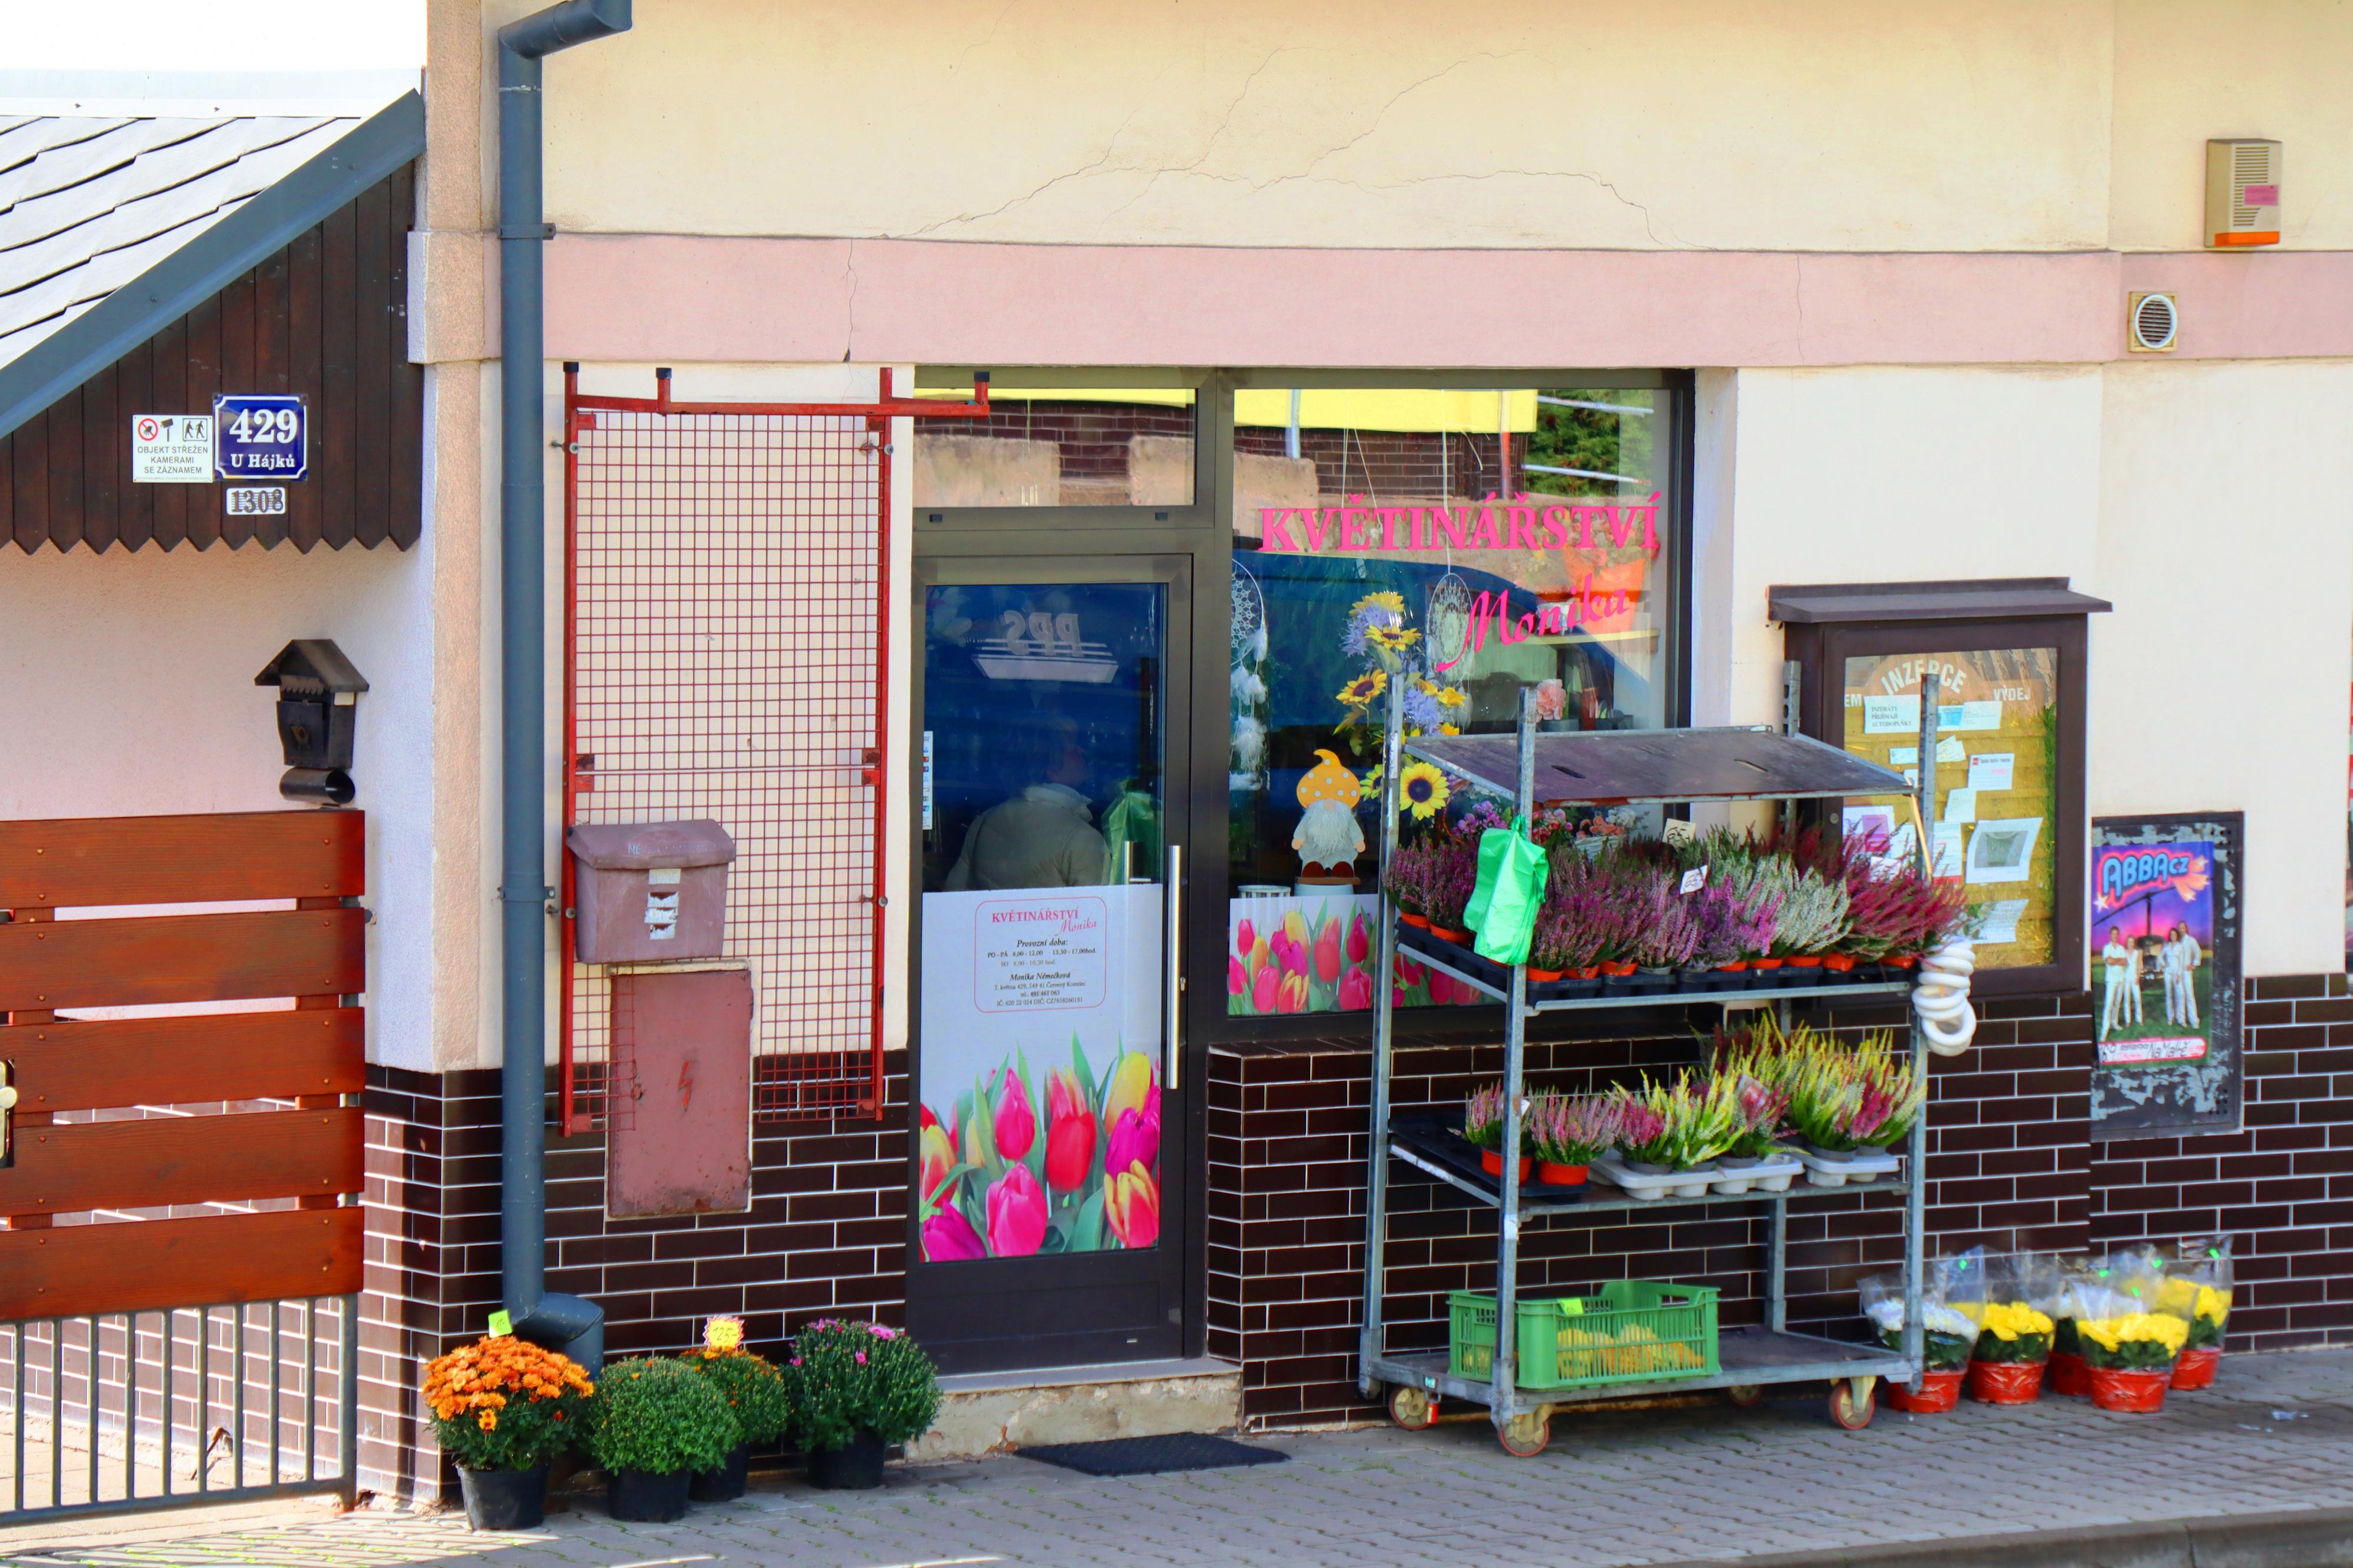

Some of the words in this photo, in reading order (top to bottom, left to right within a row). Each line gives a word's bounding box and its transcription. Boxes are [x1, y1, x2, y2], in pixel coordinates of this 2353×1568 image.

[229, 408, 298, 444] 429
[172, 445, 208, 454] STŘEŽEN
[157, 465, 202, 474] ZÁZNAMEM
[230, 455, 243, 468] U
[248, 454, 295, 471] Hájků
[231, 488, 284, 513] 1308
[1258, 491, 1661, 552] KVĚTINÁŘSTVÍ
[1435, 573, 1628, 672] Monika
[1881, 659, 1967, 695] INZERCE
[992, 906, 1079, 923] KVĚTINÁŘSTVÍ
[1054, 918, 1097, 936] Monika
[1016, 939, 1047, 948] Provozní
[1010, 973, 1034, 981] Monika
[1036, 972, 1071, 980] Němečková
